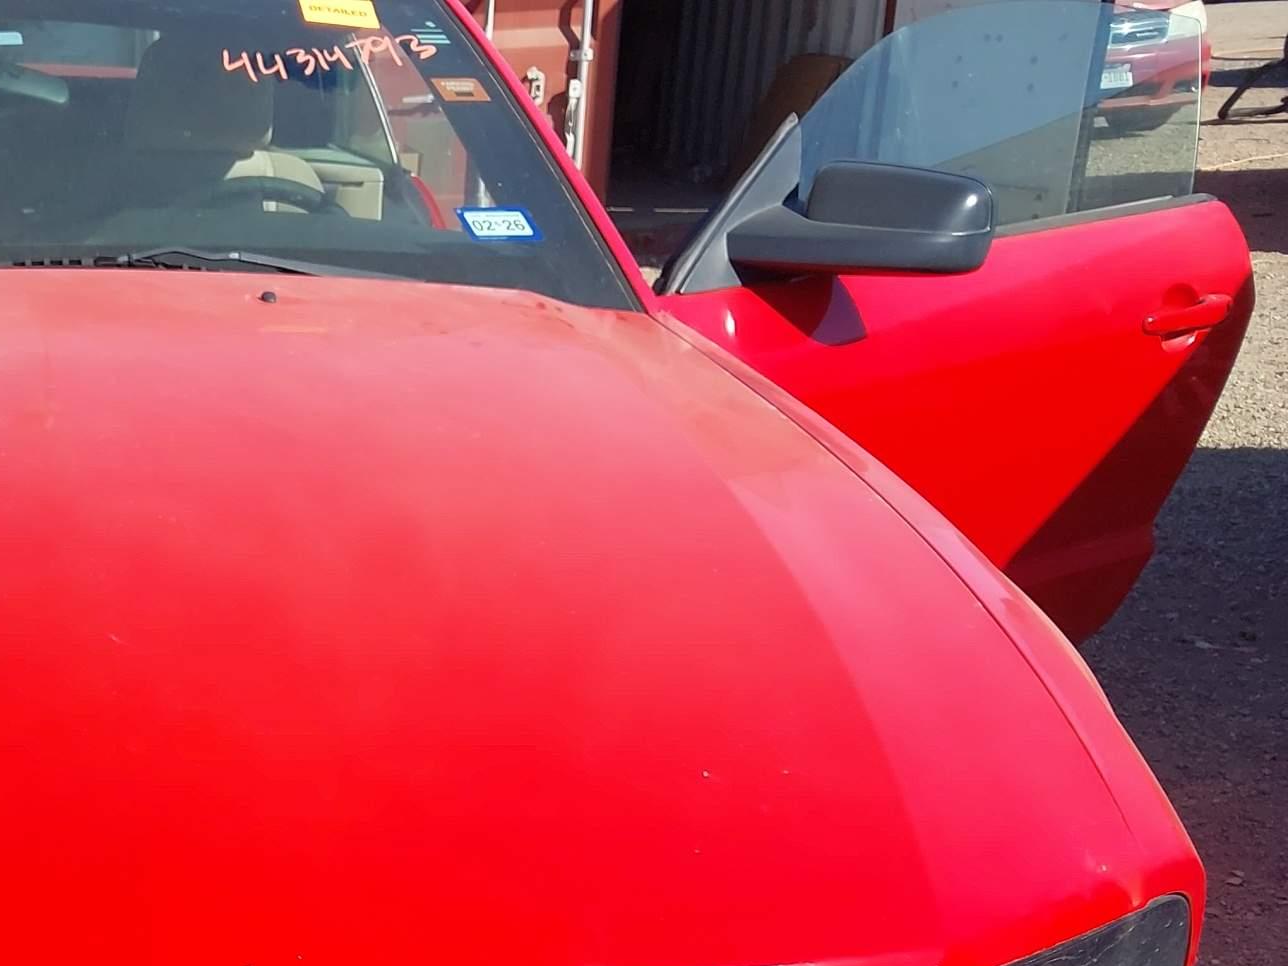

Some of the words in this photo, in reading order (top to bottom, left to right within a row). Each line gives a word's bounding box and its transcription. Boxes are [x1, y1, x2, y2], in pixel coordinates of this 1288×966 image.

[308, 5, 368, 17] DETAILED
[222, 35, 438, 83] 44314793
[471, 219, 496, 232] 02
[501, 219, 526, 232] 26
